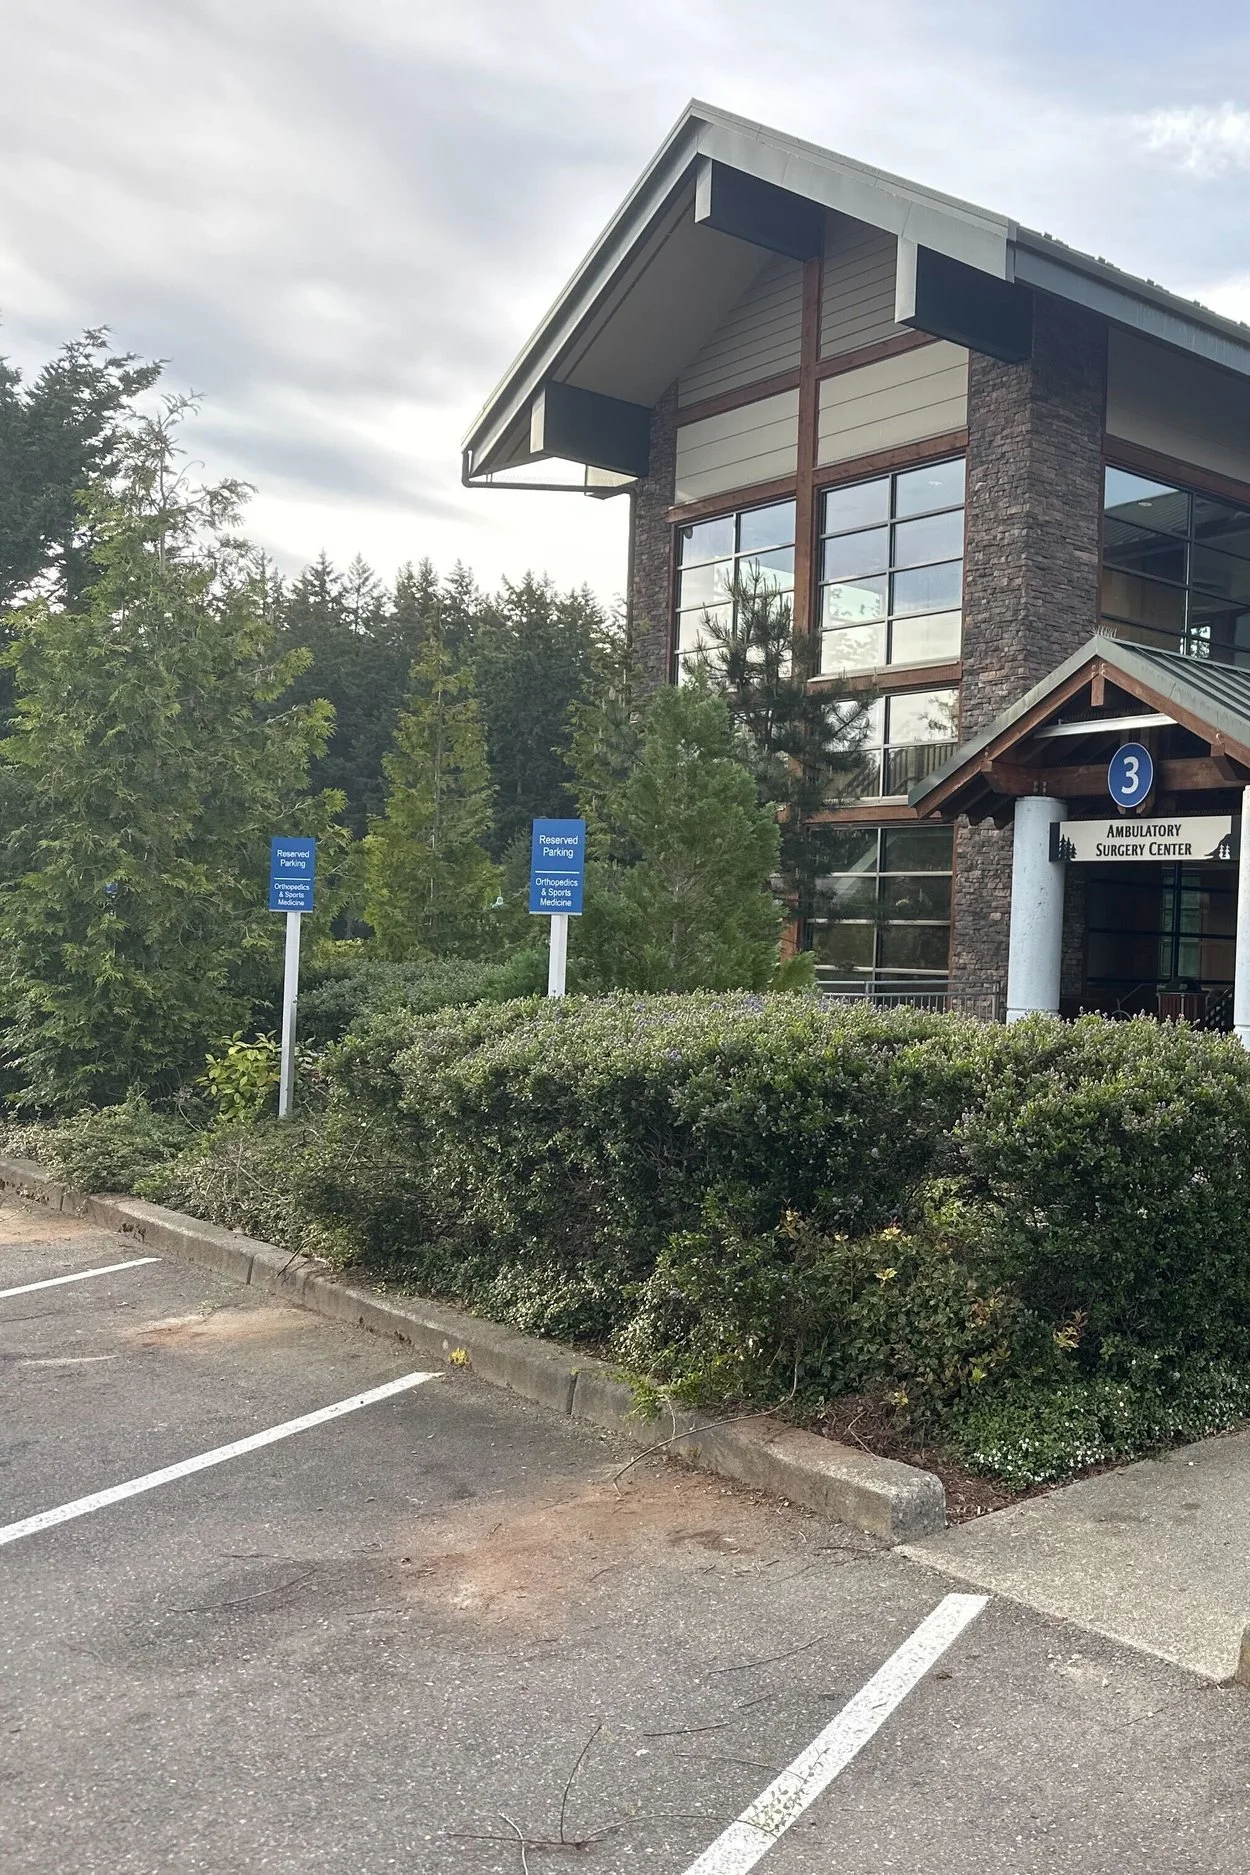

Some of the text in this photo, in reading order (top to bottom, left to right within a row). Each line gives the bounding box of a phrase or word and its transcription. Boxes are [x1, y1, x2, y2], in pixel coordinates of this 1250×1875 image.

[1121, 756, 1139, 794] 3
[1106, 823, 1182, 839] AMBULATORY
[539, 835, 579, 845] Reserved
[276, 850, 310, 858] Reserved
[543, 847, 574, 859] Parking
[1095, 841, 1192, 857] SURGERY CENTER
[280, 859, 306, 869] Parking
[274, 883, 310, 891] Orthopedics
[535, 878, 578, 887] Orthopedics
[285, 891, 305, 899] Sports
[541, 888, 572, 897] & Sports
[277, 898, 305, 906] Medicine
[539, 897, 572, 907] Medicine
